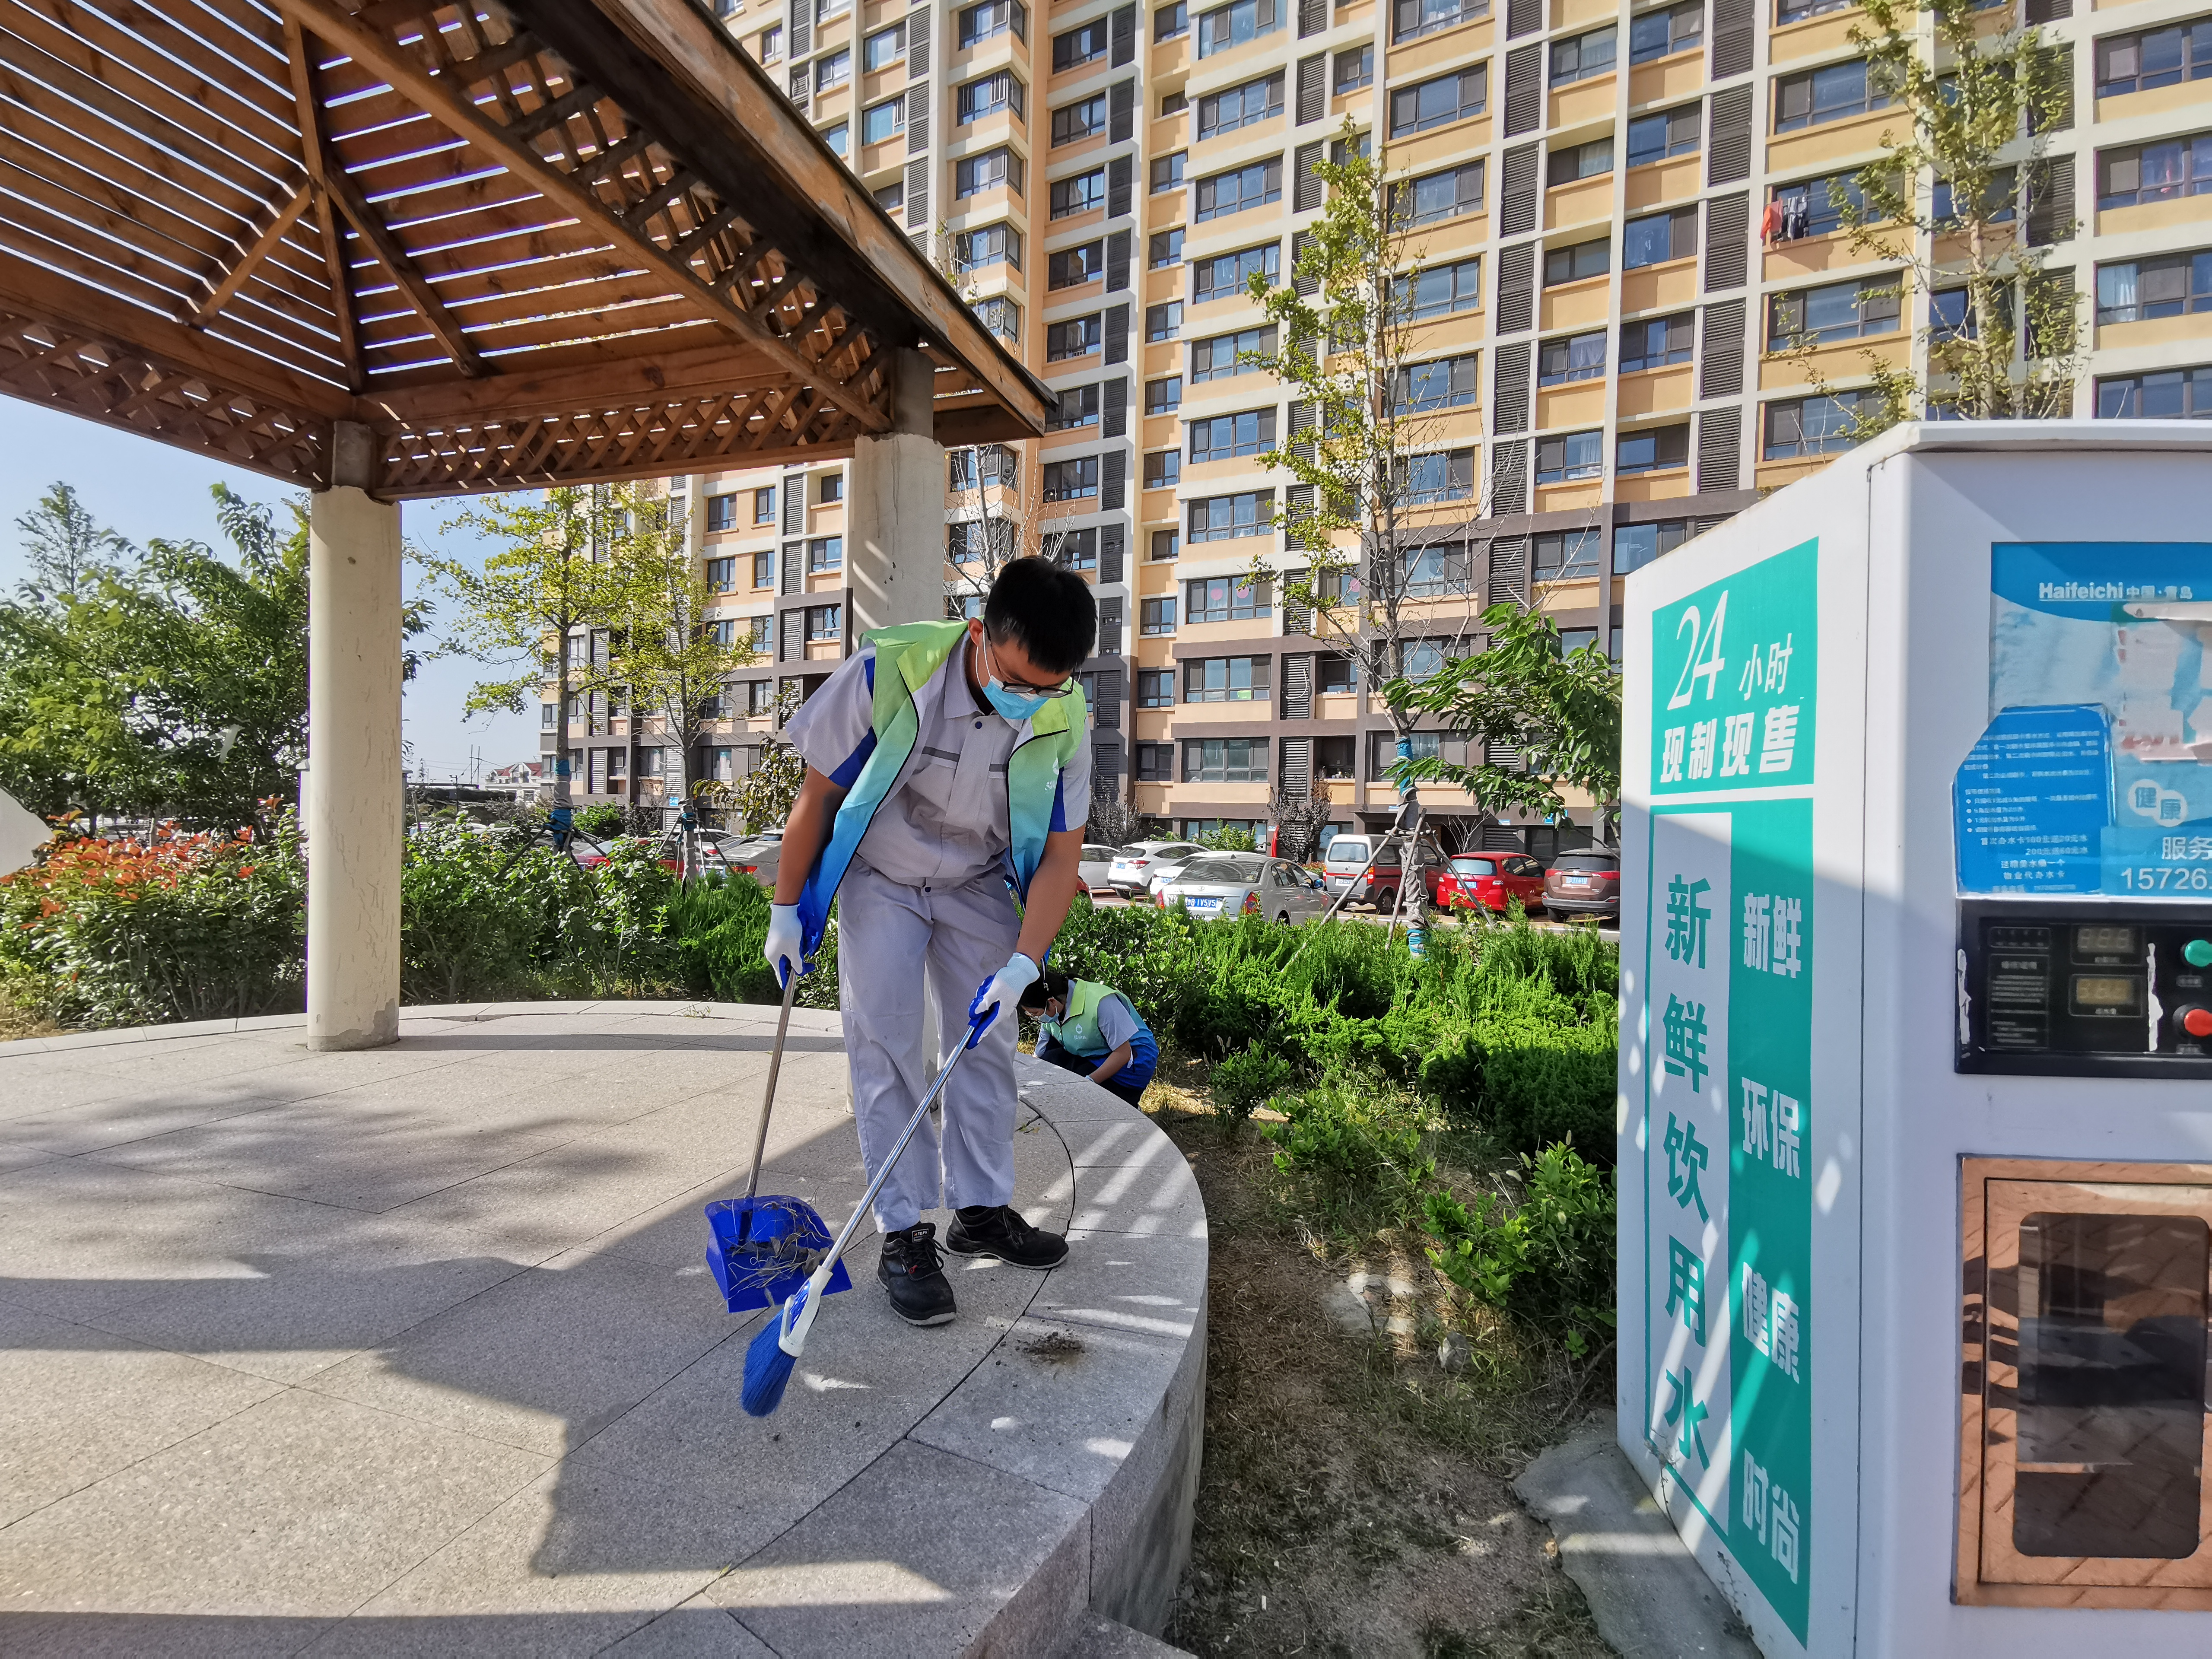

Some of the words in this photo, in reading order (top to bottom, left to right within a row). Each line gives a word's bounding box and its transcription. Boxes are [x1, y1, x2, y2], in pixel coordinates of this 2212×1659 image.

[2039, 582, 2123, 599] Haifeichi
[1666, 590, 1729, 711] 24
[1738, 632, 1793, 701] 小时
[1659, 705, 1800, 783] 现制现售
[2120, 867, 2212, 890] 15726
[1743, 892, 1802, 978] 新鲜
[1662, 874, 1711, 1470] 新鲜饮用水
[1742, 1077, 1800, 1179] 环保
[1742, 1261, 1800, 1384] 健康
[1743, 1448, 1800, 1585] 时尚
